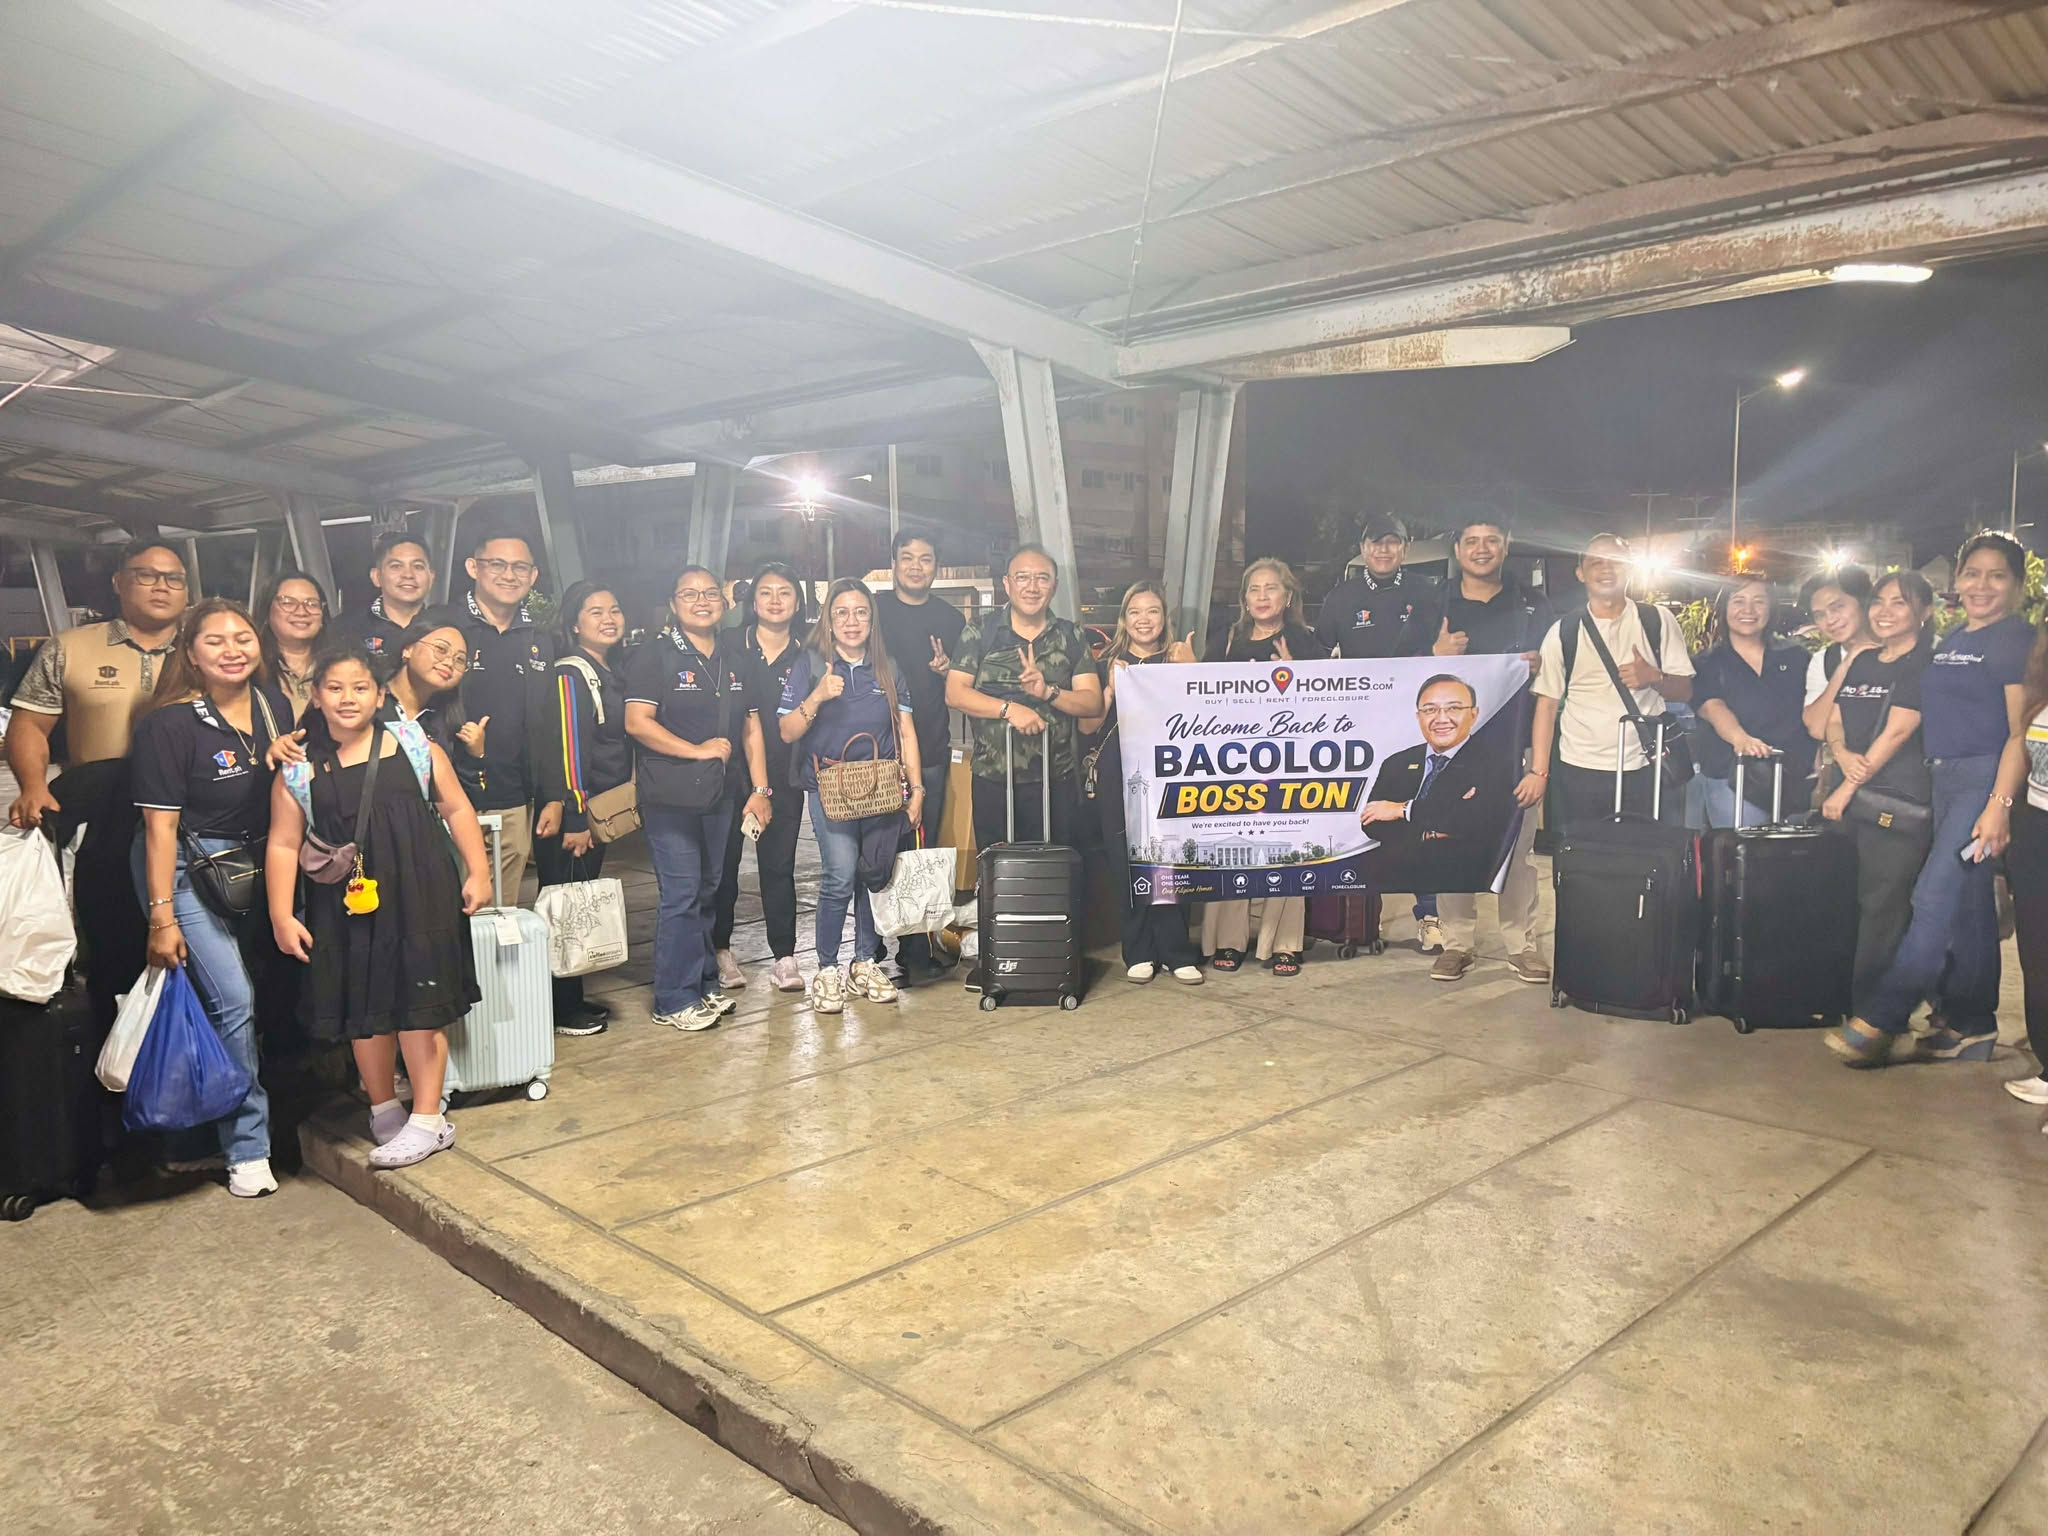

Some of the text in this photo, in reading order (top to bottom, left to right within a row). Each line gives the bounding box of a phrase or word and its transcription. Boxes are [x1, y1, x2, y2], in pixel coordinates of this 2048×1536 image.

[1186, 679, 1270, 696] FILIPINO
[1166, 710, 1356, 741] Welcome Back to
[1154, 740, 1375, 777] BACOLOD
[1176, 781, 1352, 814] BOSS TON
[1214, 820, 1241, 828] excited
